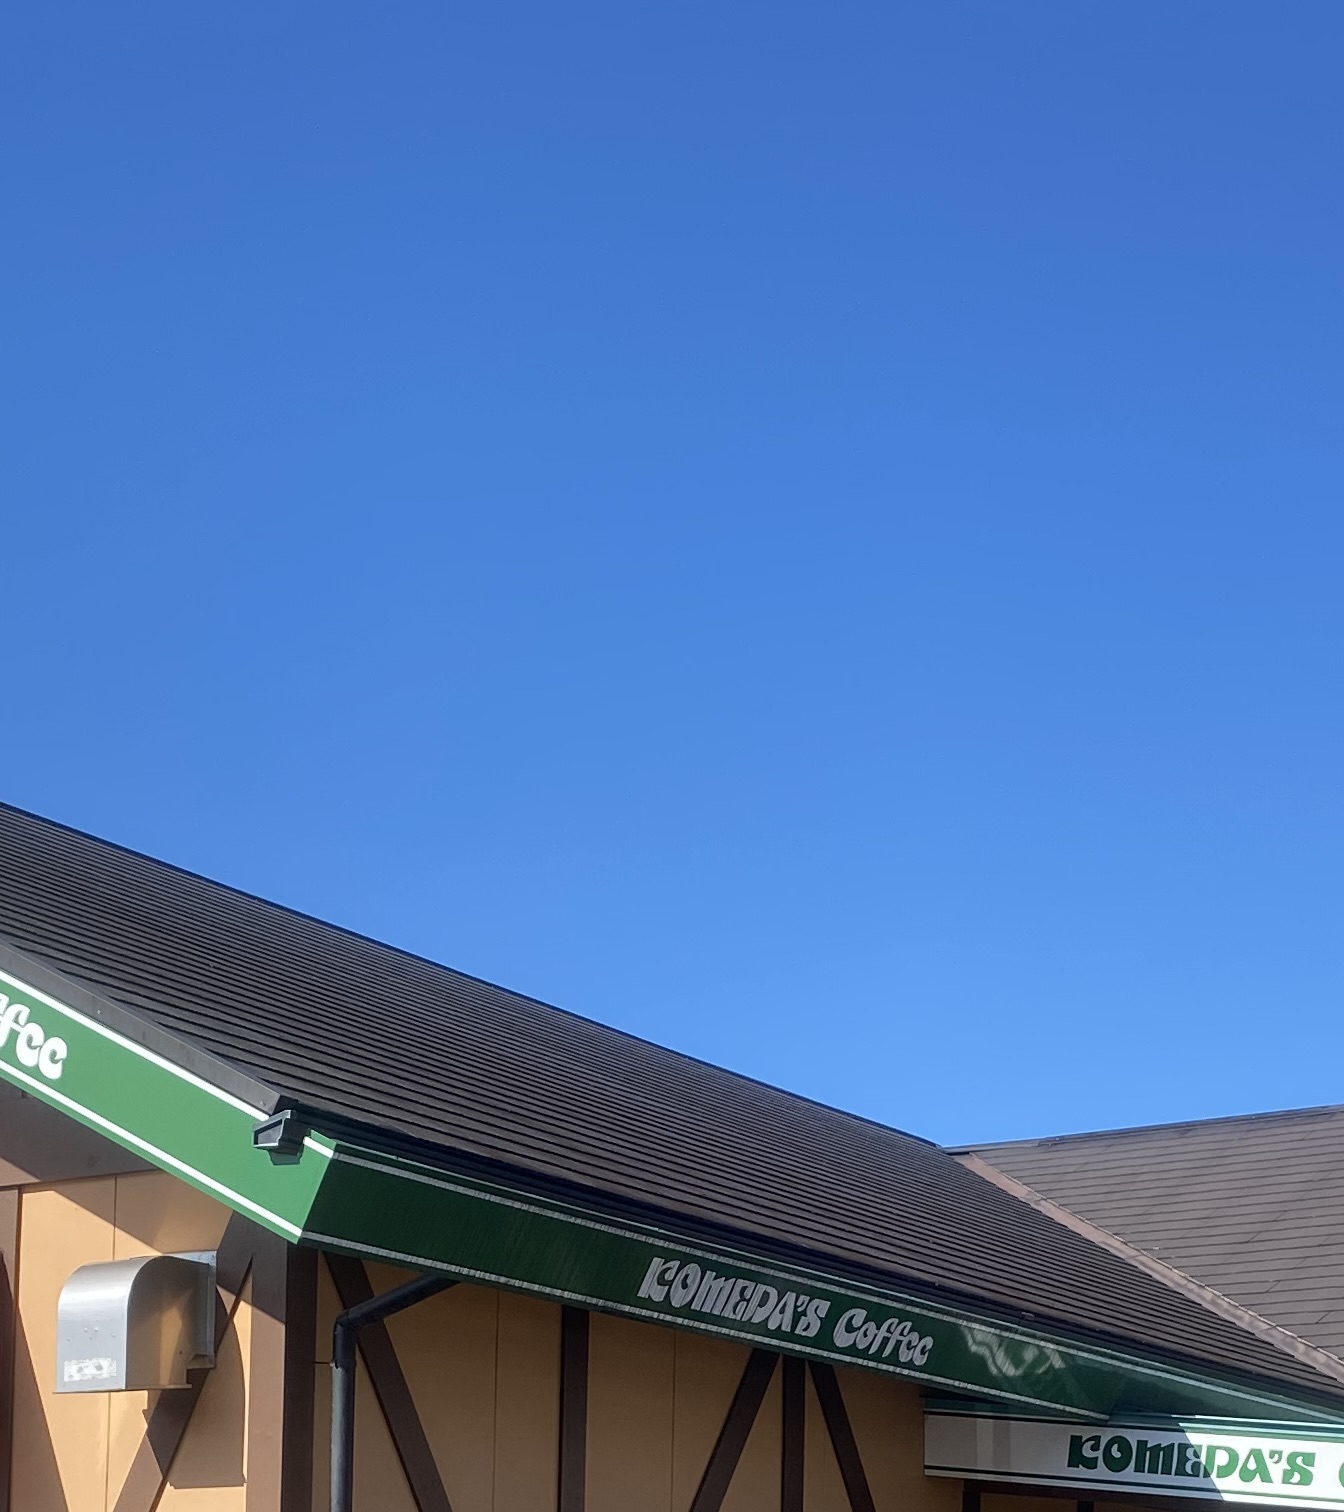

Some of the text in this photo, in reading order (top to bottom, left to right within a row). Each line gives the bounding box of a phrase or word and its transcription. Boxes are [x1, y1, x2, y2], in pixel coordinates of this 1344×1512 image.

[636, 1256, 934, 1366] KOMEDA'S Coffee
[1067, 1433, 1317, 1487] KOMEDA'S
